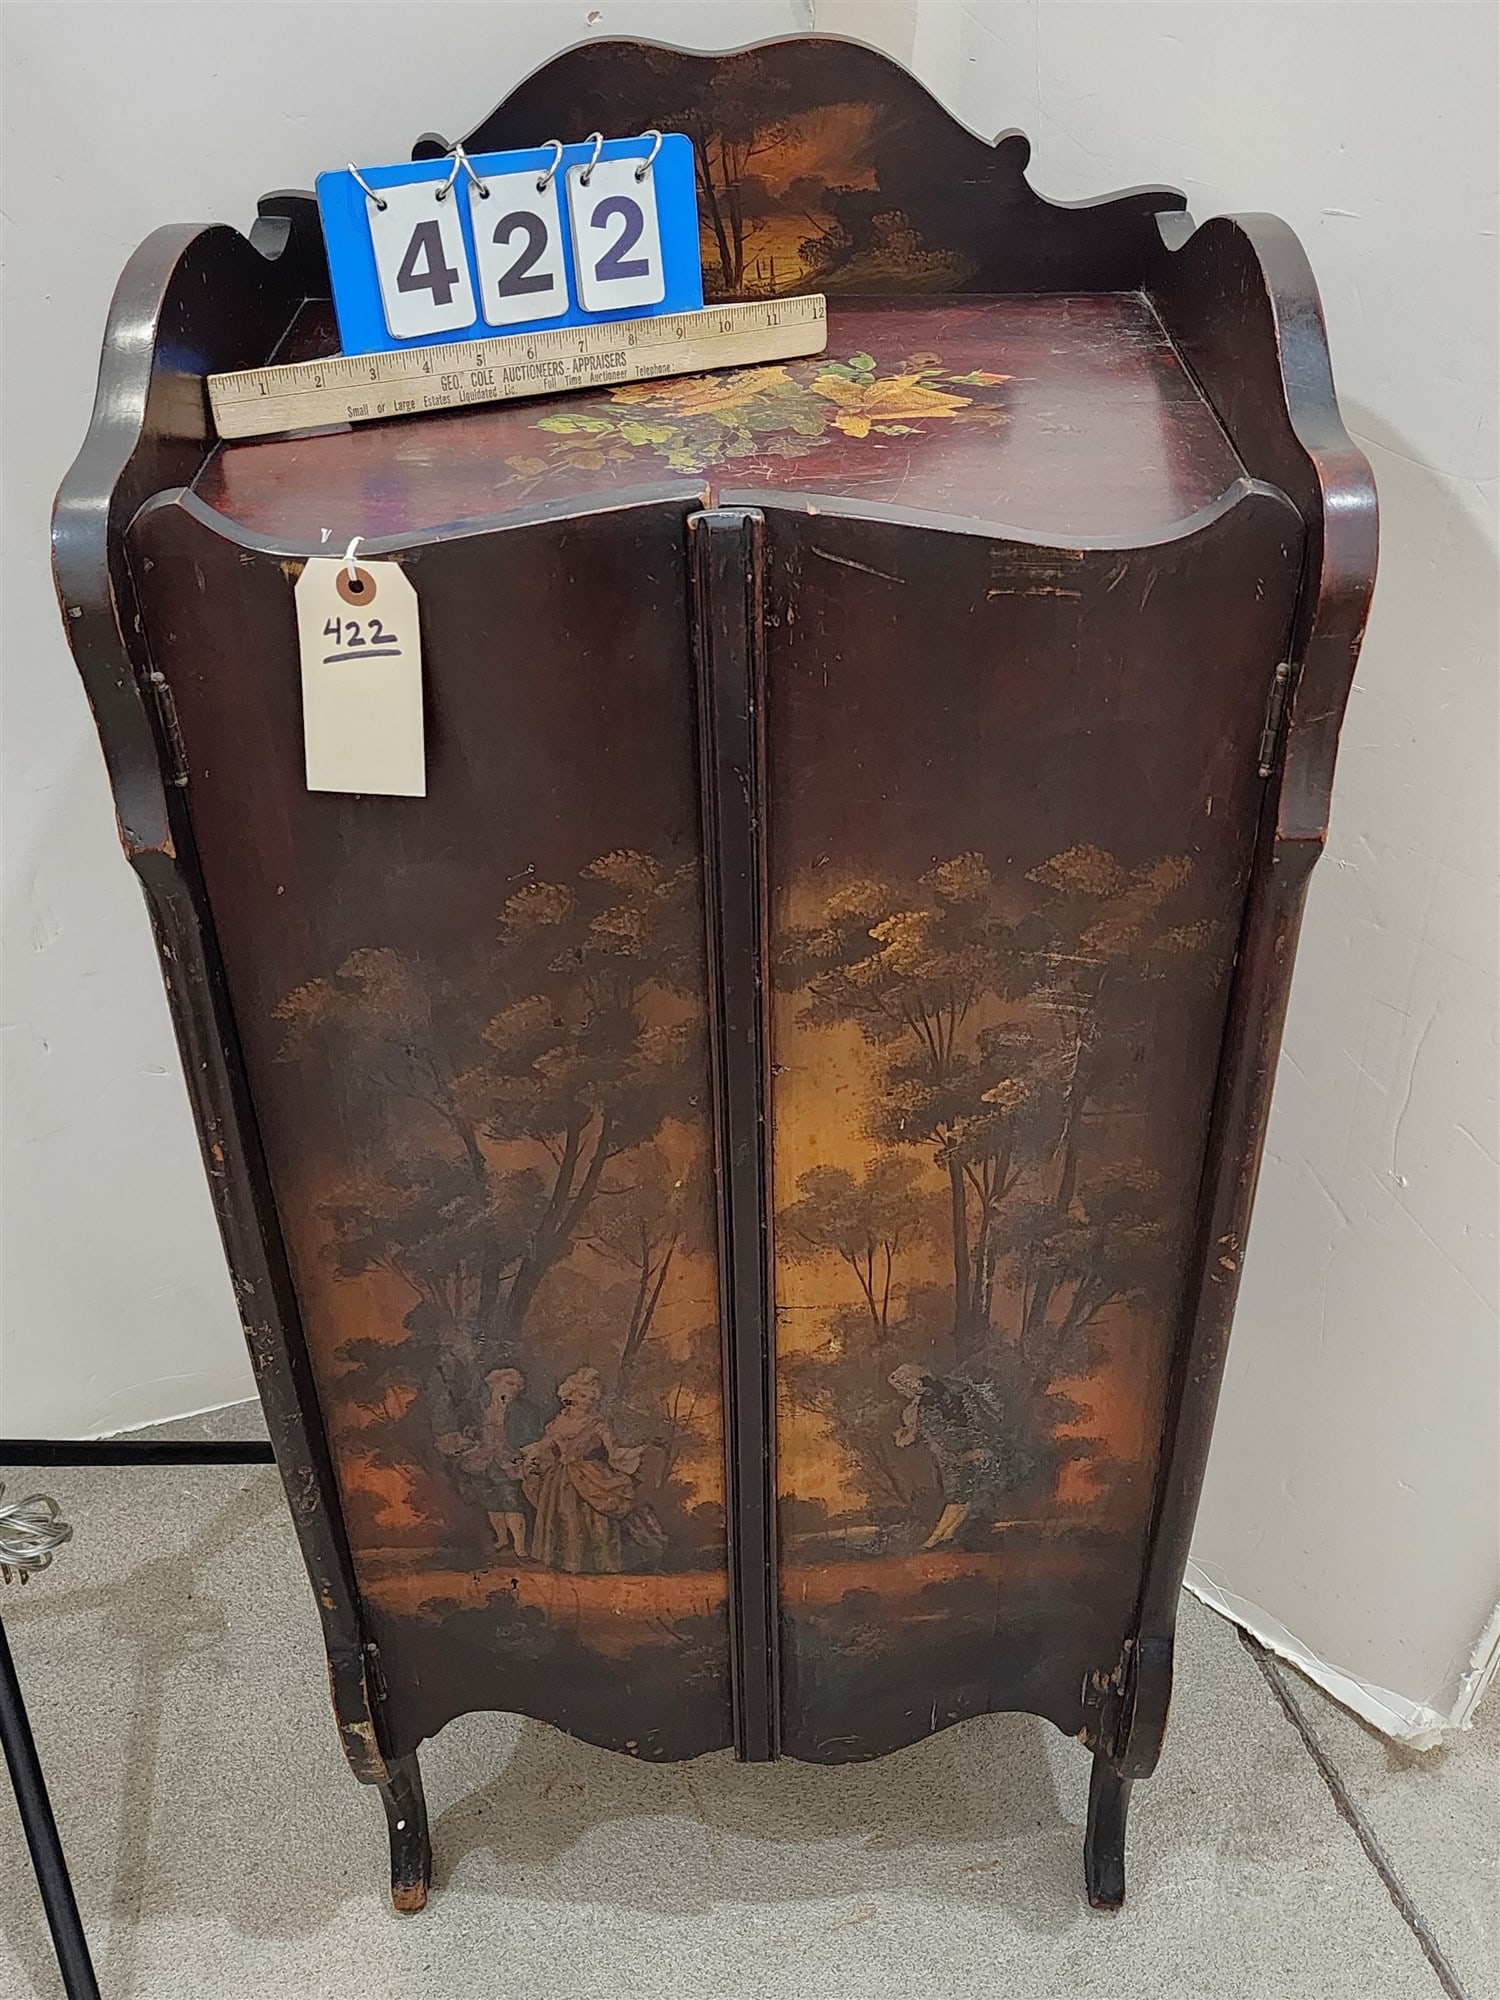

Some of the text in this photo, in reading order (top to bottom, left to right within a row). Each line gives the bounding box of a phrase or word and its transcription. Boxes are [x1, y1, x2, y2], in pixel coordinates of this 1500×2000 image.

[259, 306, 825, 395] 1 2 3 4 5 6 7 8 9 10 11 12
[441, 375, 463, 391] GEO.
[471, 370, 495, 387] COLE
[503, 361, 565, 383] AUCTIONEERS
[573, 352, 627, 373] APPRAISERS
[347, 404, 369, 418] Small
[377, 403, 386, 414] or
[394, 400, 416, 413] Large
[423, 395, 451, 407] Estates
[543, 379, 557, 389] Full
[565, 375, 582, 387] Time
[590, 369, 628, 383] Auctioneer
[323, 617, 398, 647] 422
